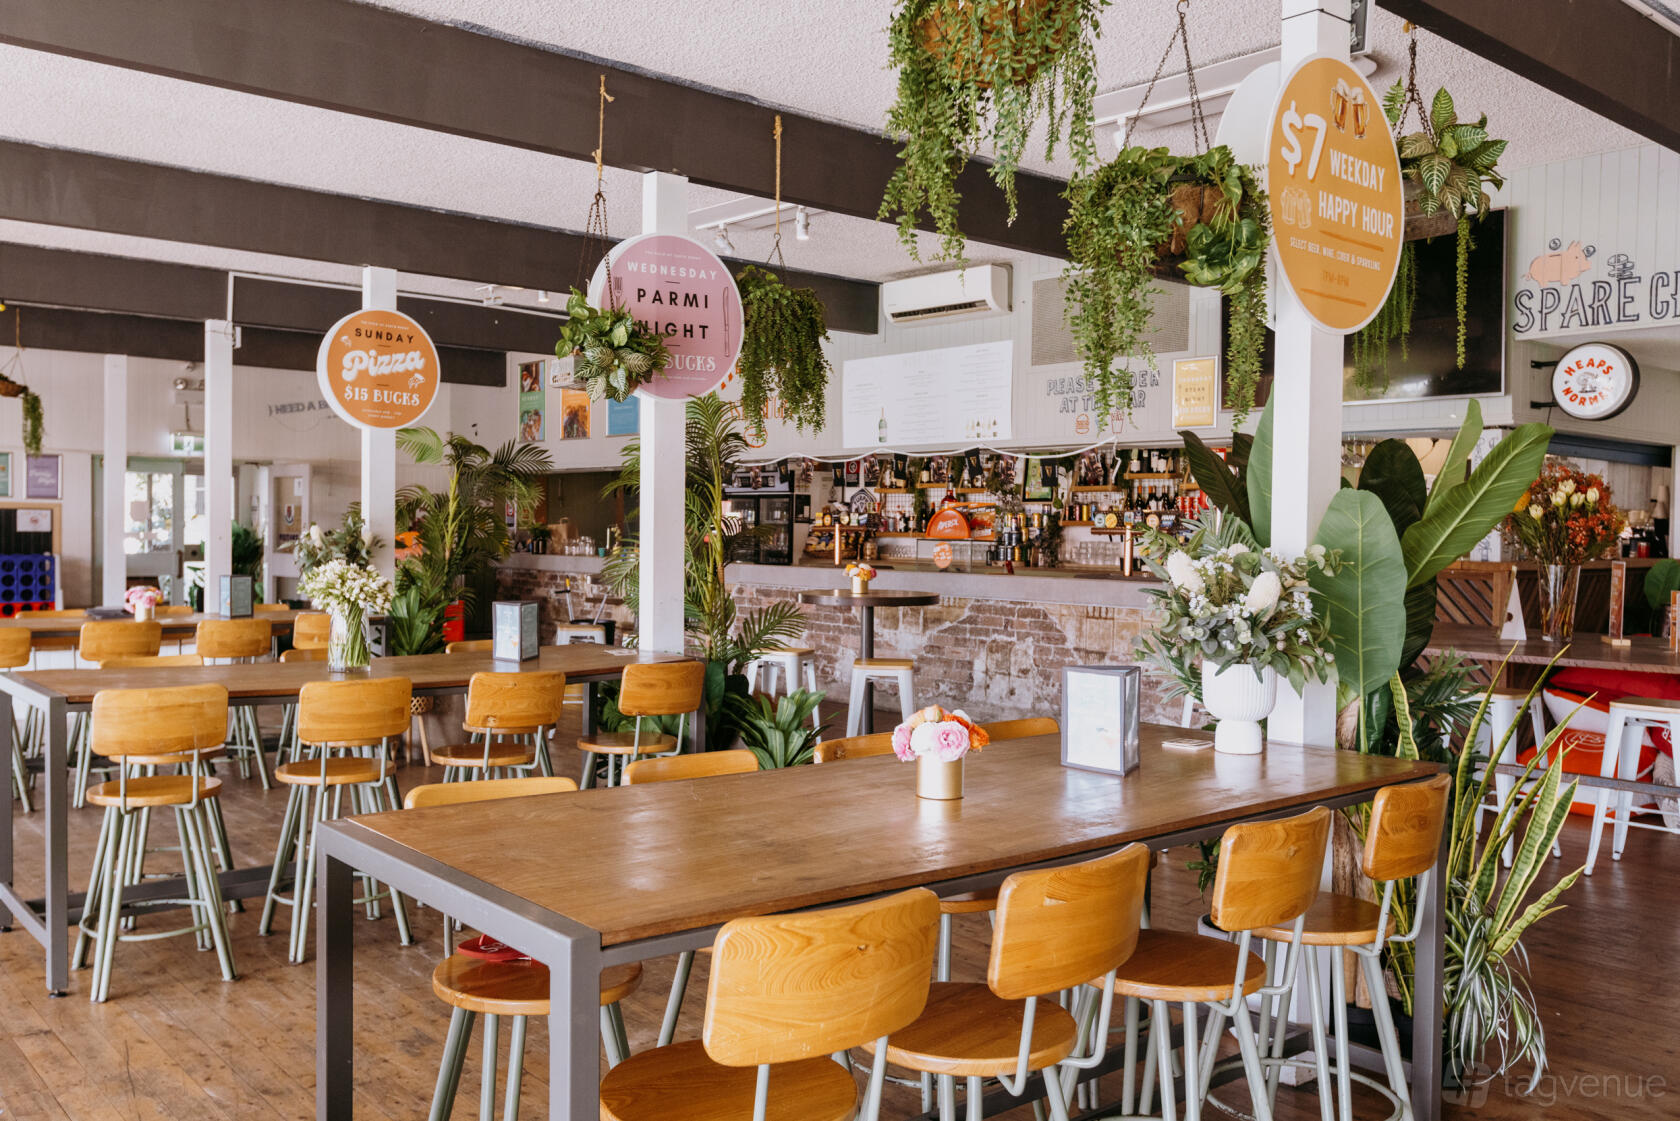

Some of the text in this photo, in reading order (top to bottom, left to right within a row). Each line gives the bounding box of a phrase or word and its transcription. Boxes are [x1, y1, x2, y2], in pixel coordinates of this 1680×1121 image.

[1281, 100, 1327, 180] $7
[1330, 149, 1385, 193] WEEKDAY
[1319, 190, 1394, 239] HAPPY HOUR
[627, 261, 717, 281] WEDNESDAY
[637, 288, 709, 309] PARMI
[1513, 276, 1641, 333] SPARE
[355, 328, 414, 344] SUNDAY
[638, 320, 709, 339] NIGHT
[342, 349, 425, 382] Pizza
[1564, 357, 1613, 376] HEAPS
[344, 384, 420, 407] $15 BUCKS
[1046, 375, 1095, 396] PLEASE
[1562, 386, 1611, 406] NORMA
[1059, 396, 1078, 413] AT
